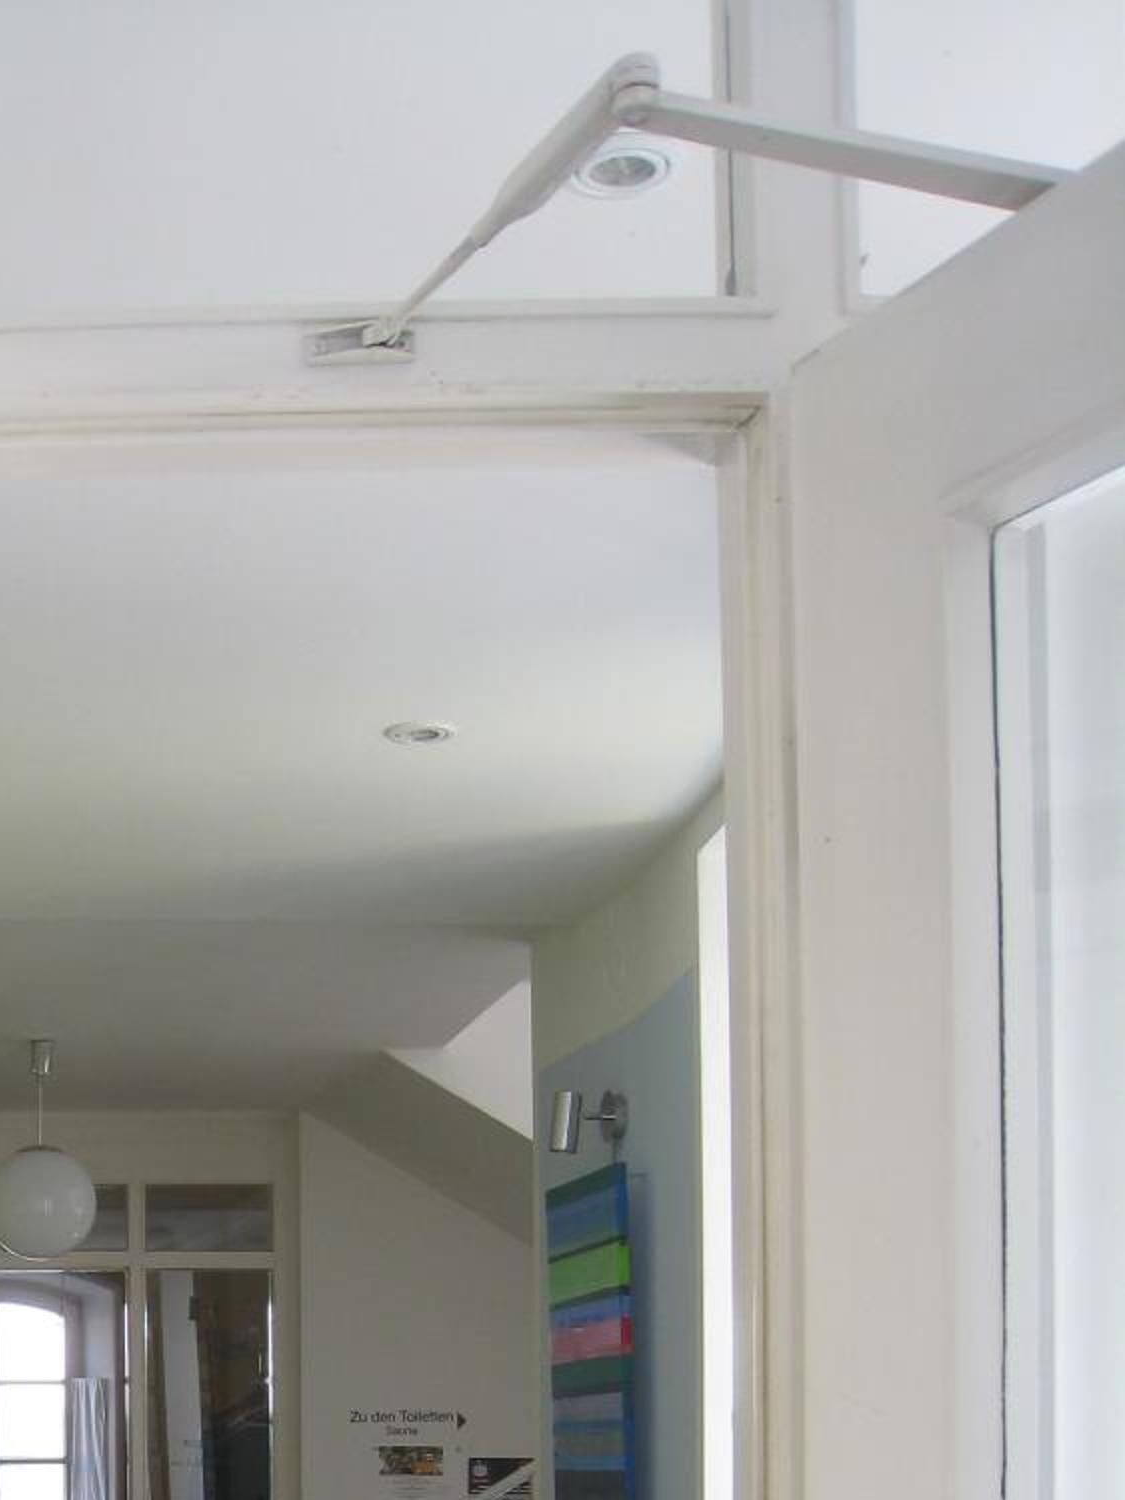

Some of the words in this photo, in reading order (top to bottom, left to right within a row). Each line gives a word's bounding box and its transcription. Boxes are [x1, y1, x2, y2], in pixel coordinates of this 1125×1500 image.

[350, 1410, 367, 1423] Zu
[371, 1410, 395, 1423] den
[399, 1410, 454, 1423] Toiletten
